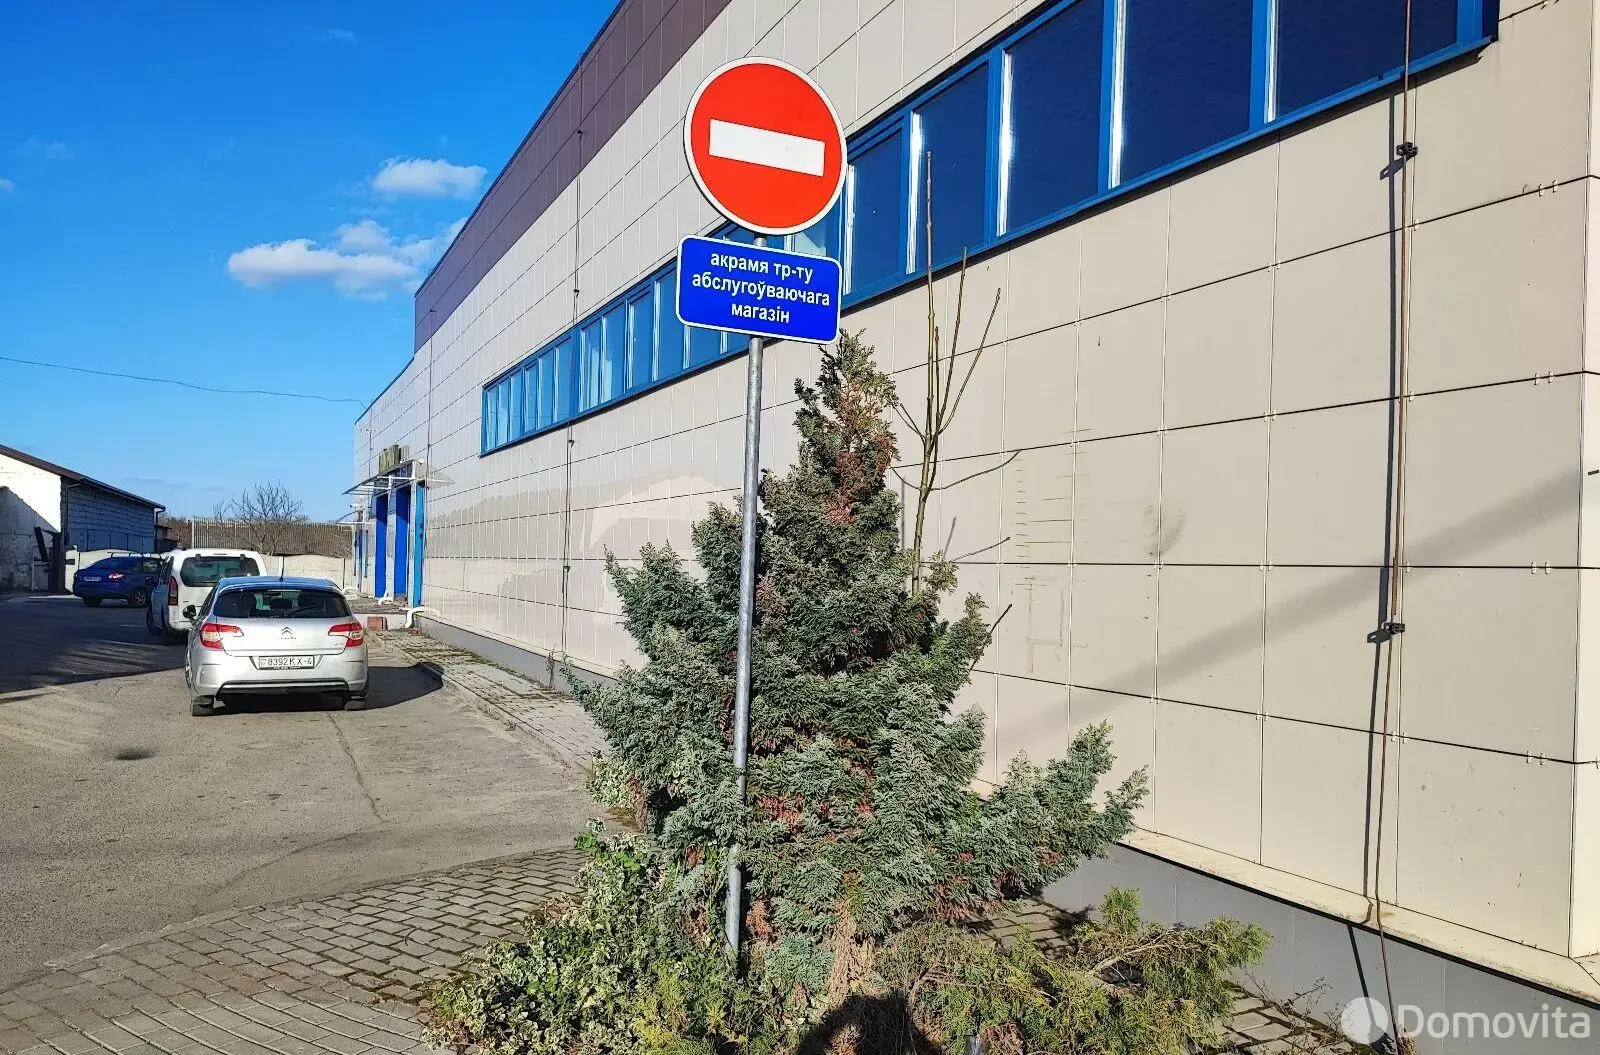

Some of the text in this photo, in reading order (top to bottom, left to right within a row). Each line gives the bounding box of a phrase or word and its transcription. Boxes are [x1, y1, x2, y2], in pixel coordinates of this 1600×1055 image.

[711, 253, 813, 284] акрамя тр-ту
[692, 272, 830, 306] абслугоўваючага
[731, 303, 790, 323] магазін
